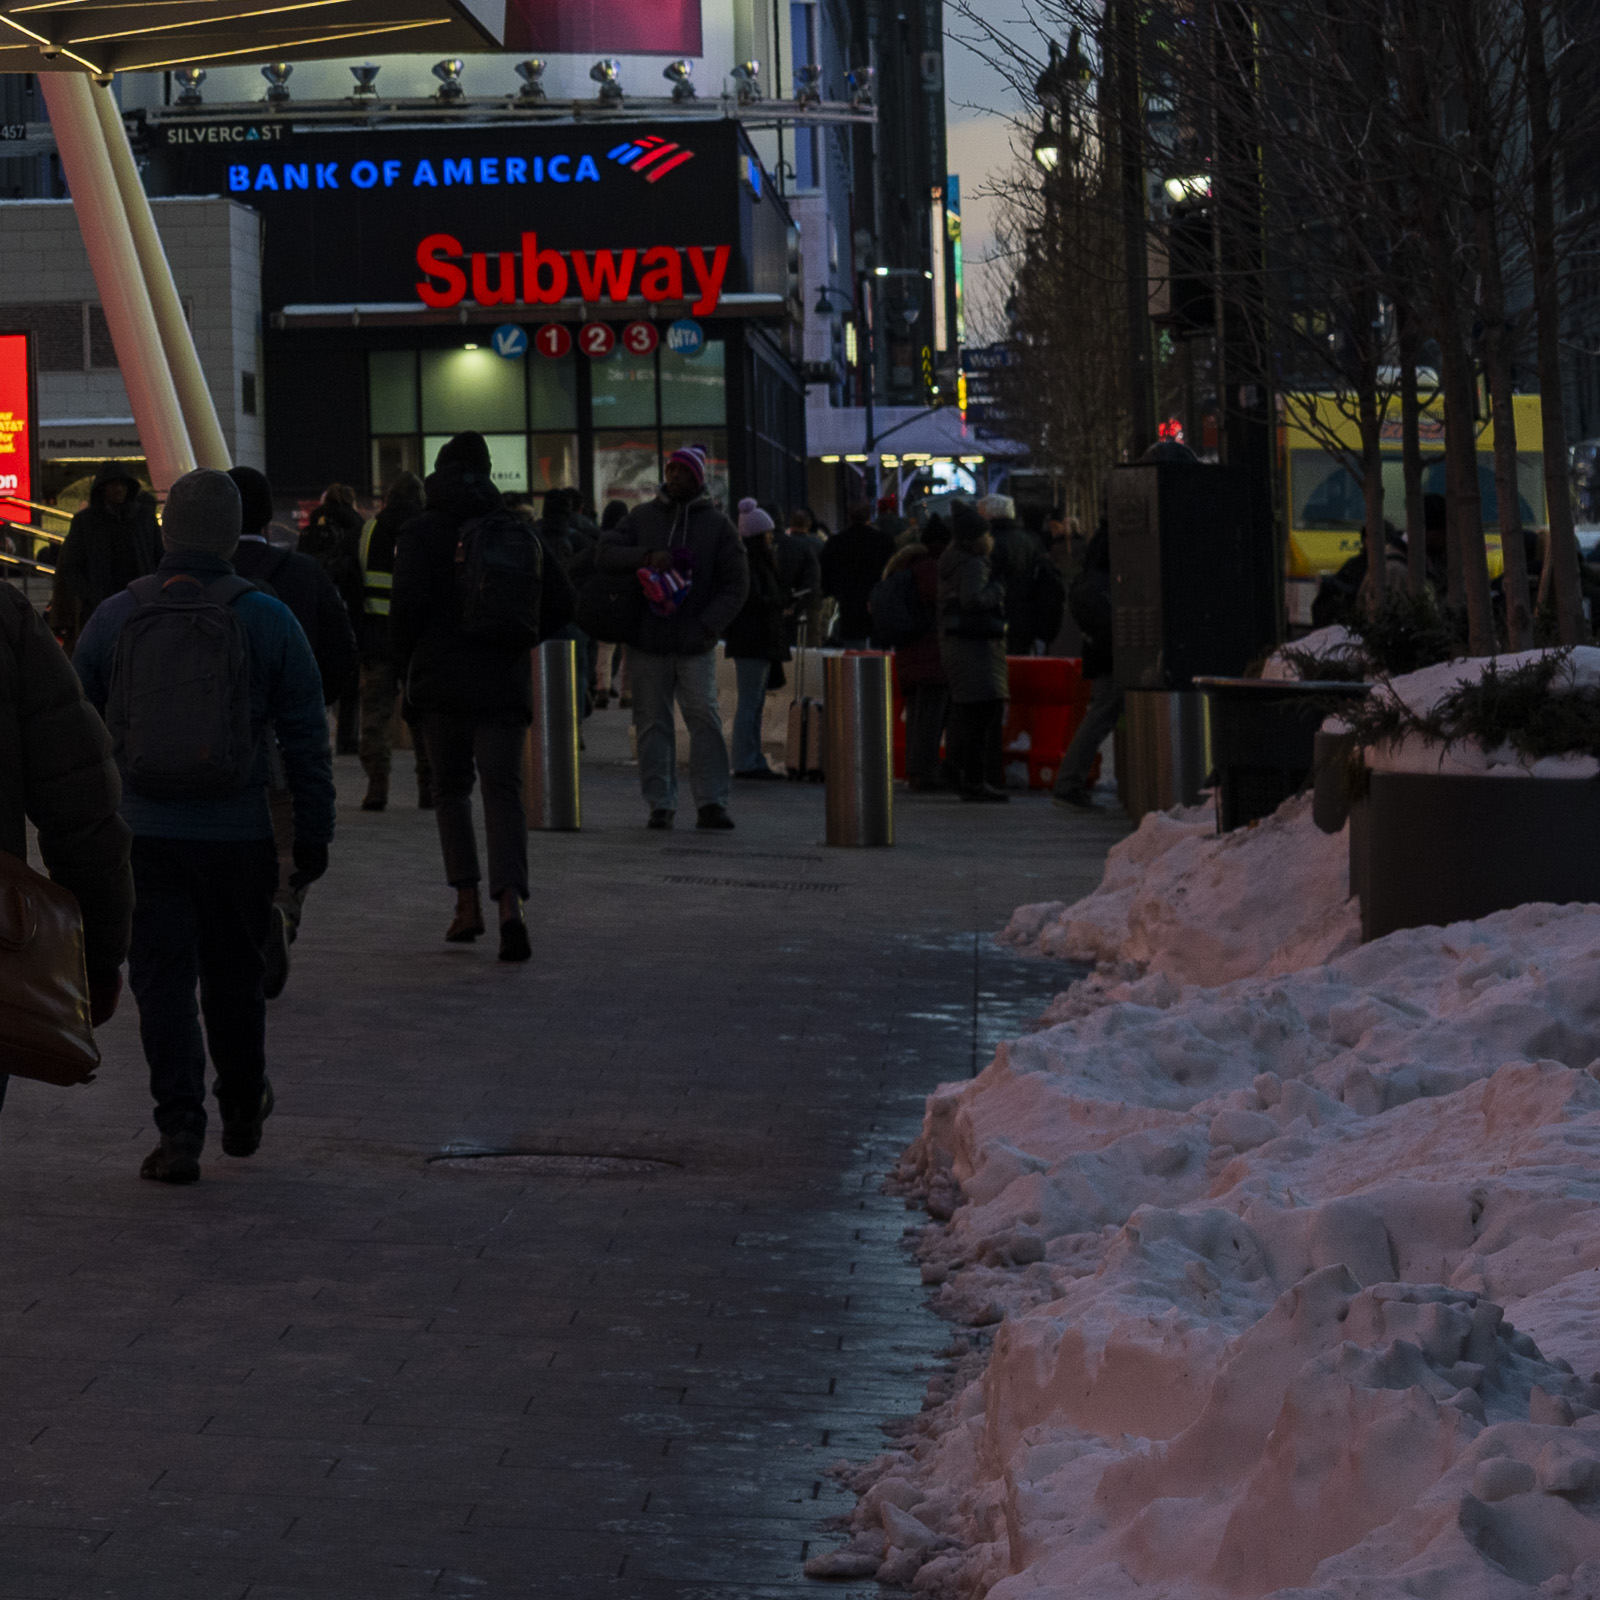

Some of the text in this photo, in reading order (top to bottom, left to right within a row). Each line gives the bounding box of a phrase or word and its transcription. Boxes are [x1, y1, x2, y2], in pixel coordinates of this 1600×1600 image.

[228, 154, 600, 191] BANK OF AMERICA
[415, 232, 731, 316] Subway
[545, 328, 558, 353] 1
[588, 326, 607, 352] 2
[631, 325, 650, 351] 3
